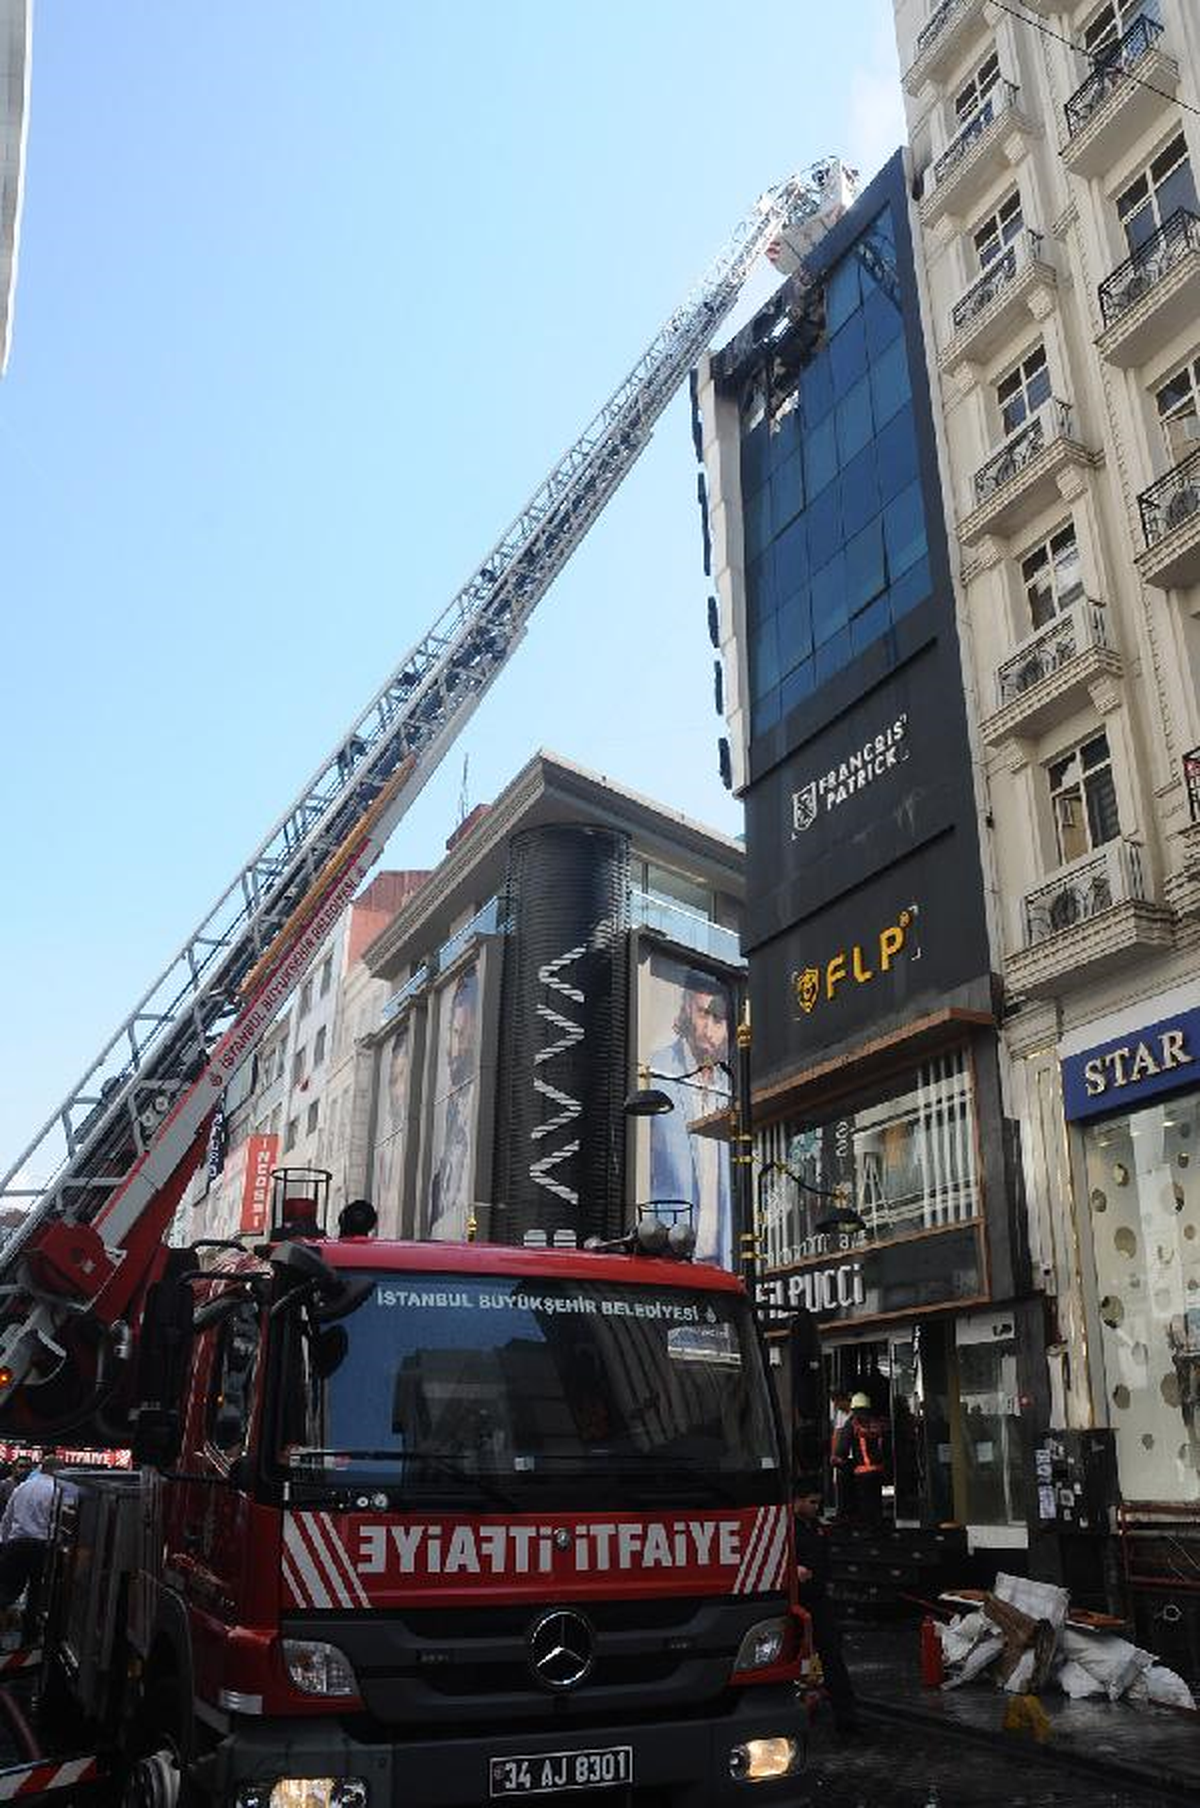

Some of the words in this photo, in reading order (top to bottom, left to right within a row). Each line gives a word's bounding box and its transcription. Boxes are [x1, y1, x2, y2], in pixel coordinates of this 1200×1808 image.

[826, 746, 896, 811] PATRICK
[826, 926, 904, 1001] FLP
[1085, 1031, 1193, 1097] STAR
[377, 1286, 474, 1307] İSTANBUL
[601, 1300, 699, 1322] BELEDİYESİ
[505, 1761, 531, 1789] 34
[541, 1757, 567, 1787] AJ
[575, 1751, 625, 1783] 8301
